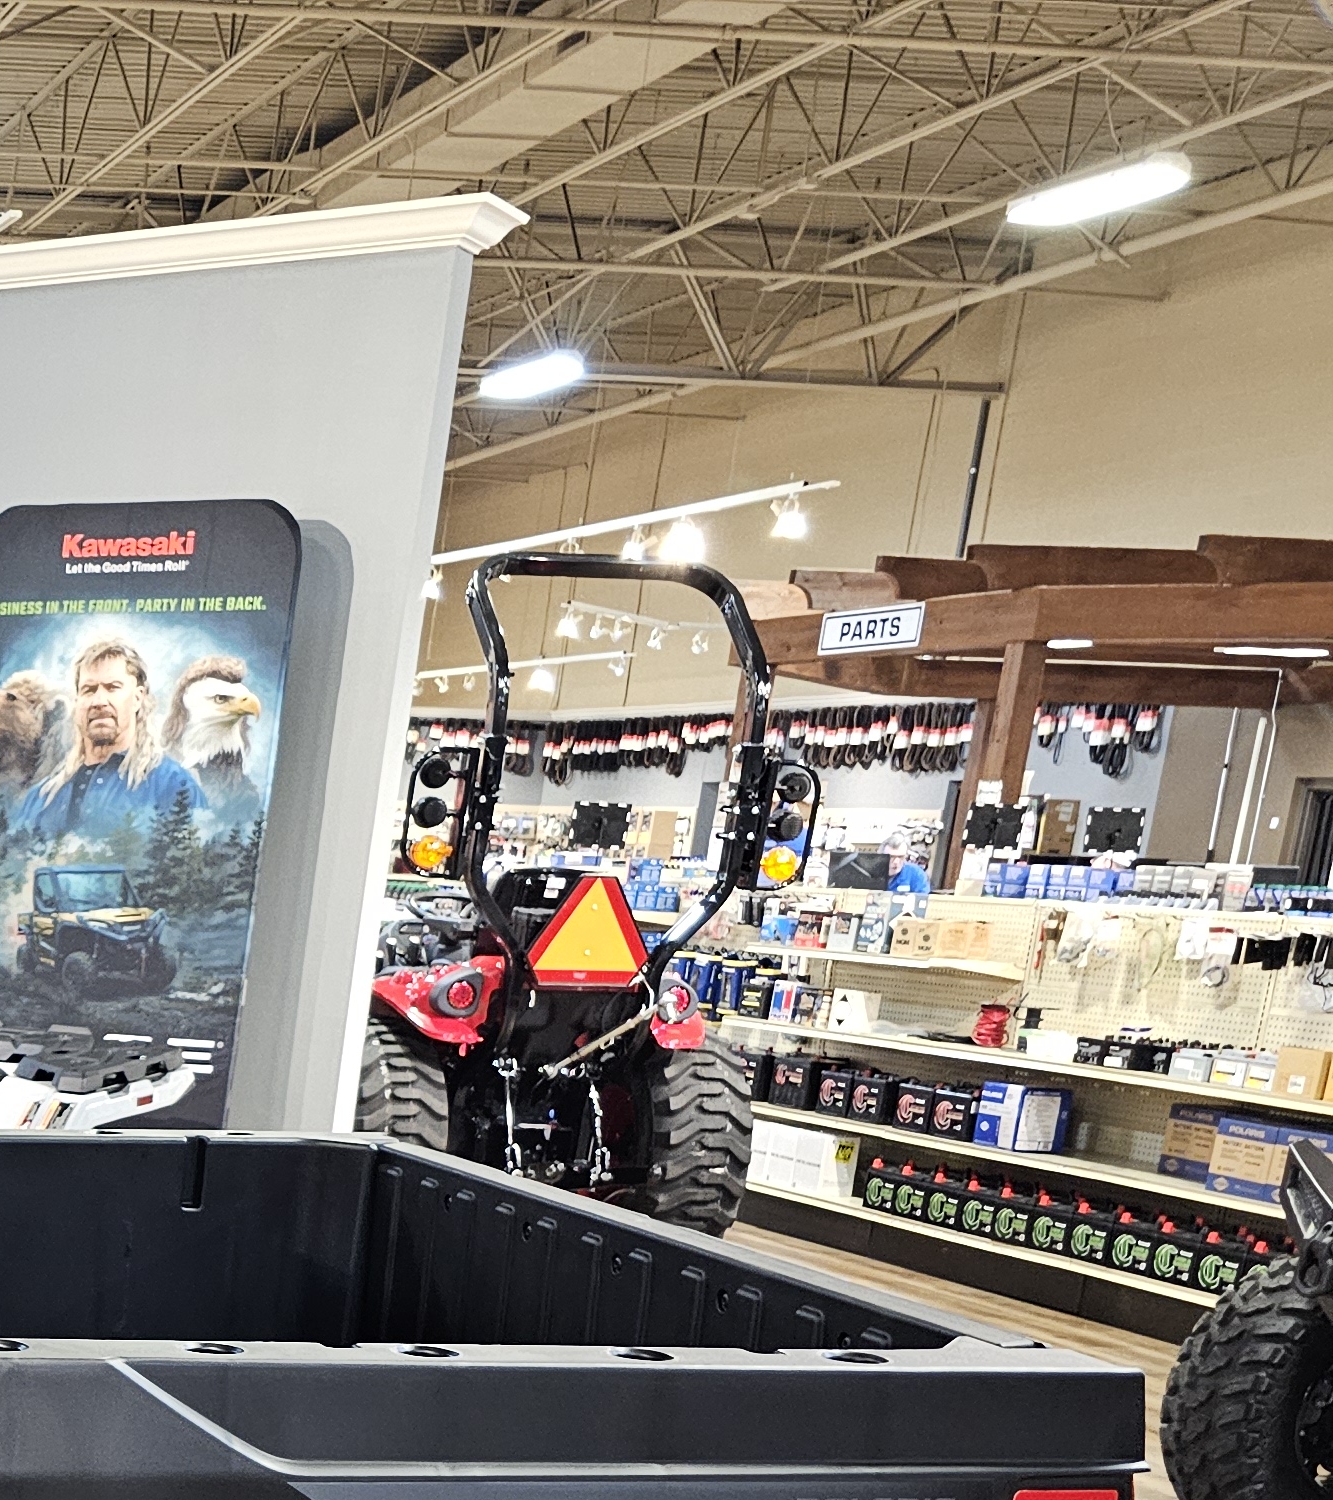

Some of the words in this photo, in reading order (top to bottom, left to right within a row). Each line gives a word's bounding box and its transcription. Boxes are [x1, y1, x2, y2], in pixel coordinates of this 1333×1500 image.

[61, 530, 196, 559] Kawasaki
[65, 562, 83, 575] Let
[84, 561, 102, 574] the
[102, 561, 131, 573] Good
[132, 560, 163, 573] Times
[45, 600, 60, 615] IN
[62, 600, 85, 615] THE
[135, 598, 178, 613] PARTY
[181, 597, 195, 612] IN
[198, 597, 223, 612] THE
[226, 596, 267, 611] BACK.
[838, 616, 901, 642] PARTS
